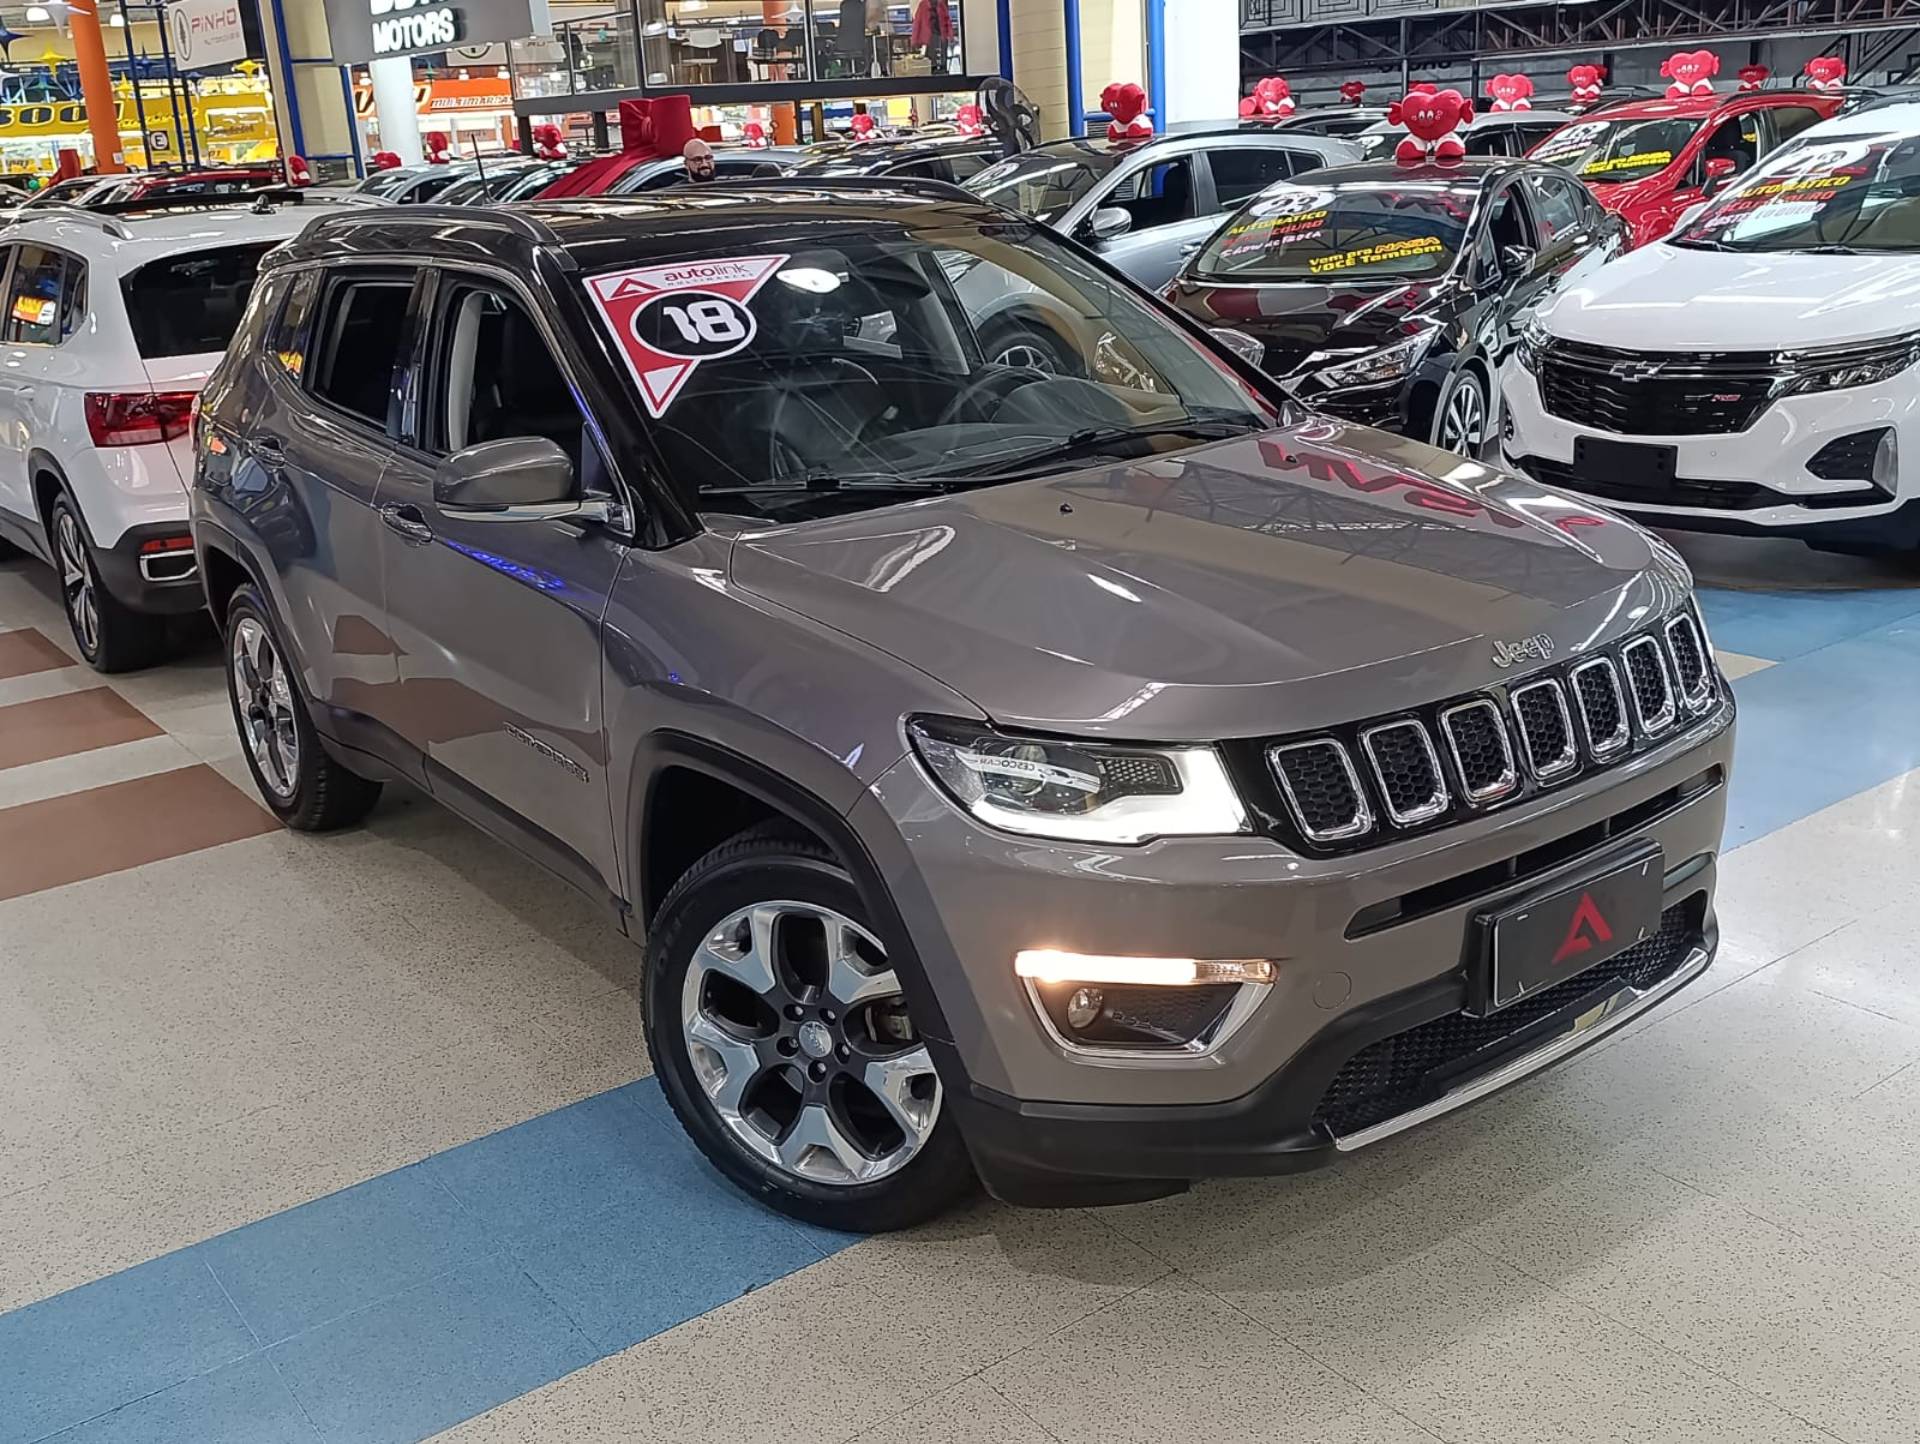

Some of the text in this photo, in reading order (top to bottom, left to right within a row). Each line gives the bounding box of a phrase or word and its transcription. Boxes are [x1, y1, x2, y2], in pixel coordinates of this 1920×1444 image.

[372, 8, 456, 54] MOTORS
[1259, 195, 1318, 216] 23
[1308, 253, 1344, 267] Vem
[1346, 248, 1372, 260] pra
[663, 263, 751, 282] autolink
[662, 299, 747, 344] 18
[1491, 632, 1555, 668] Jeep
